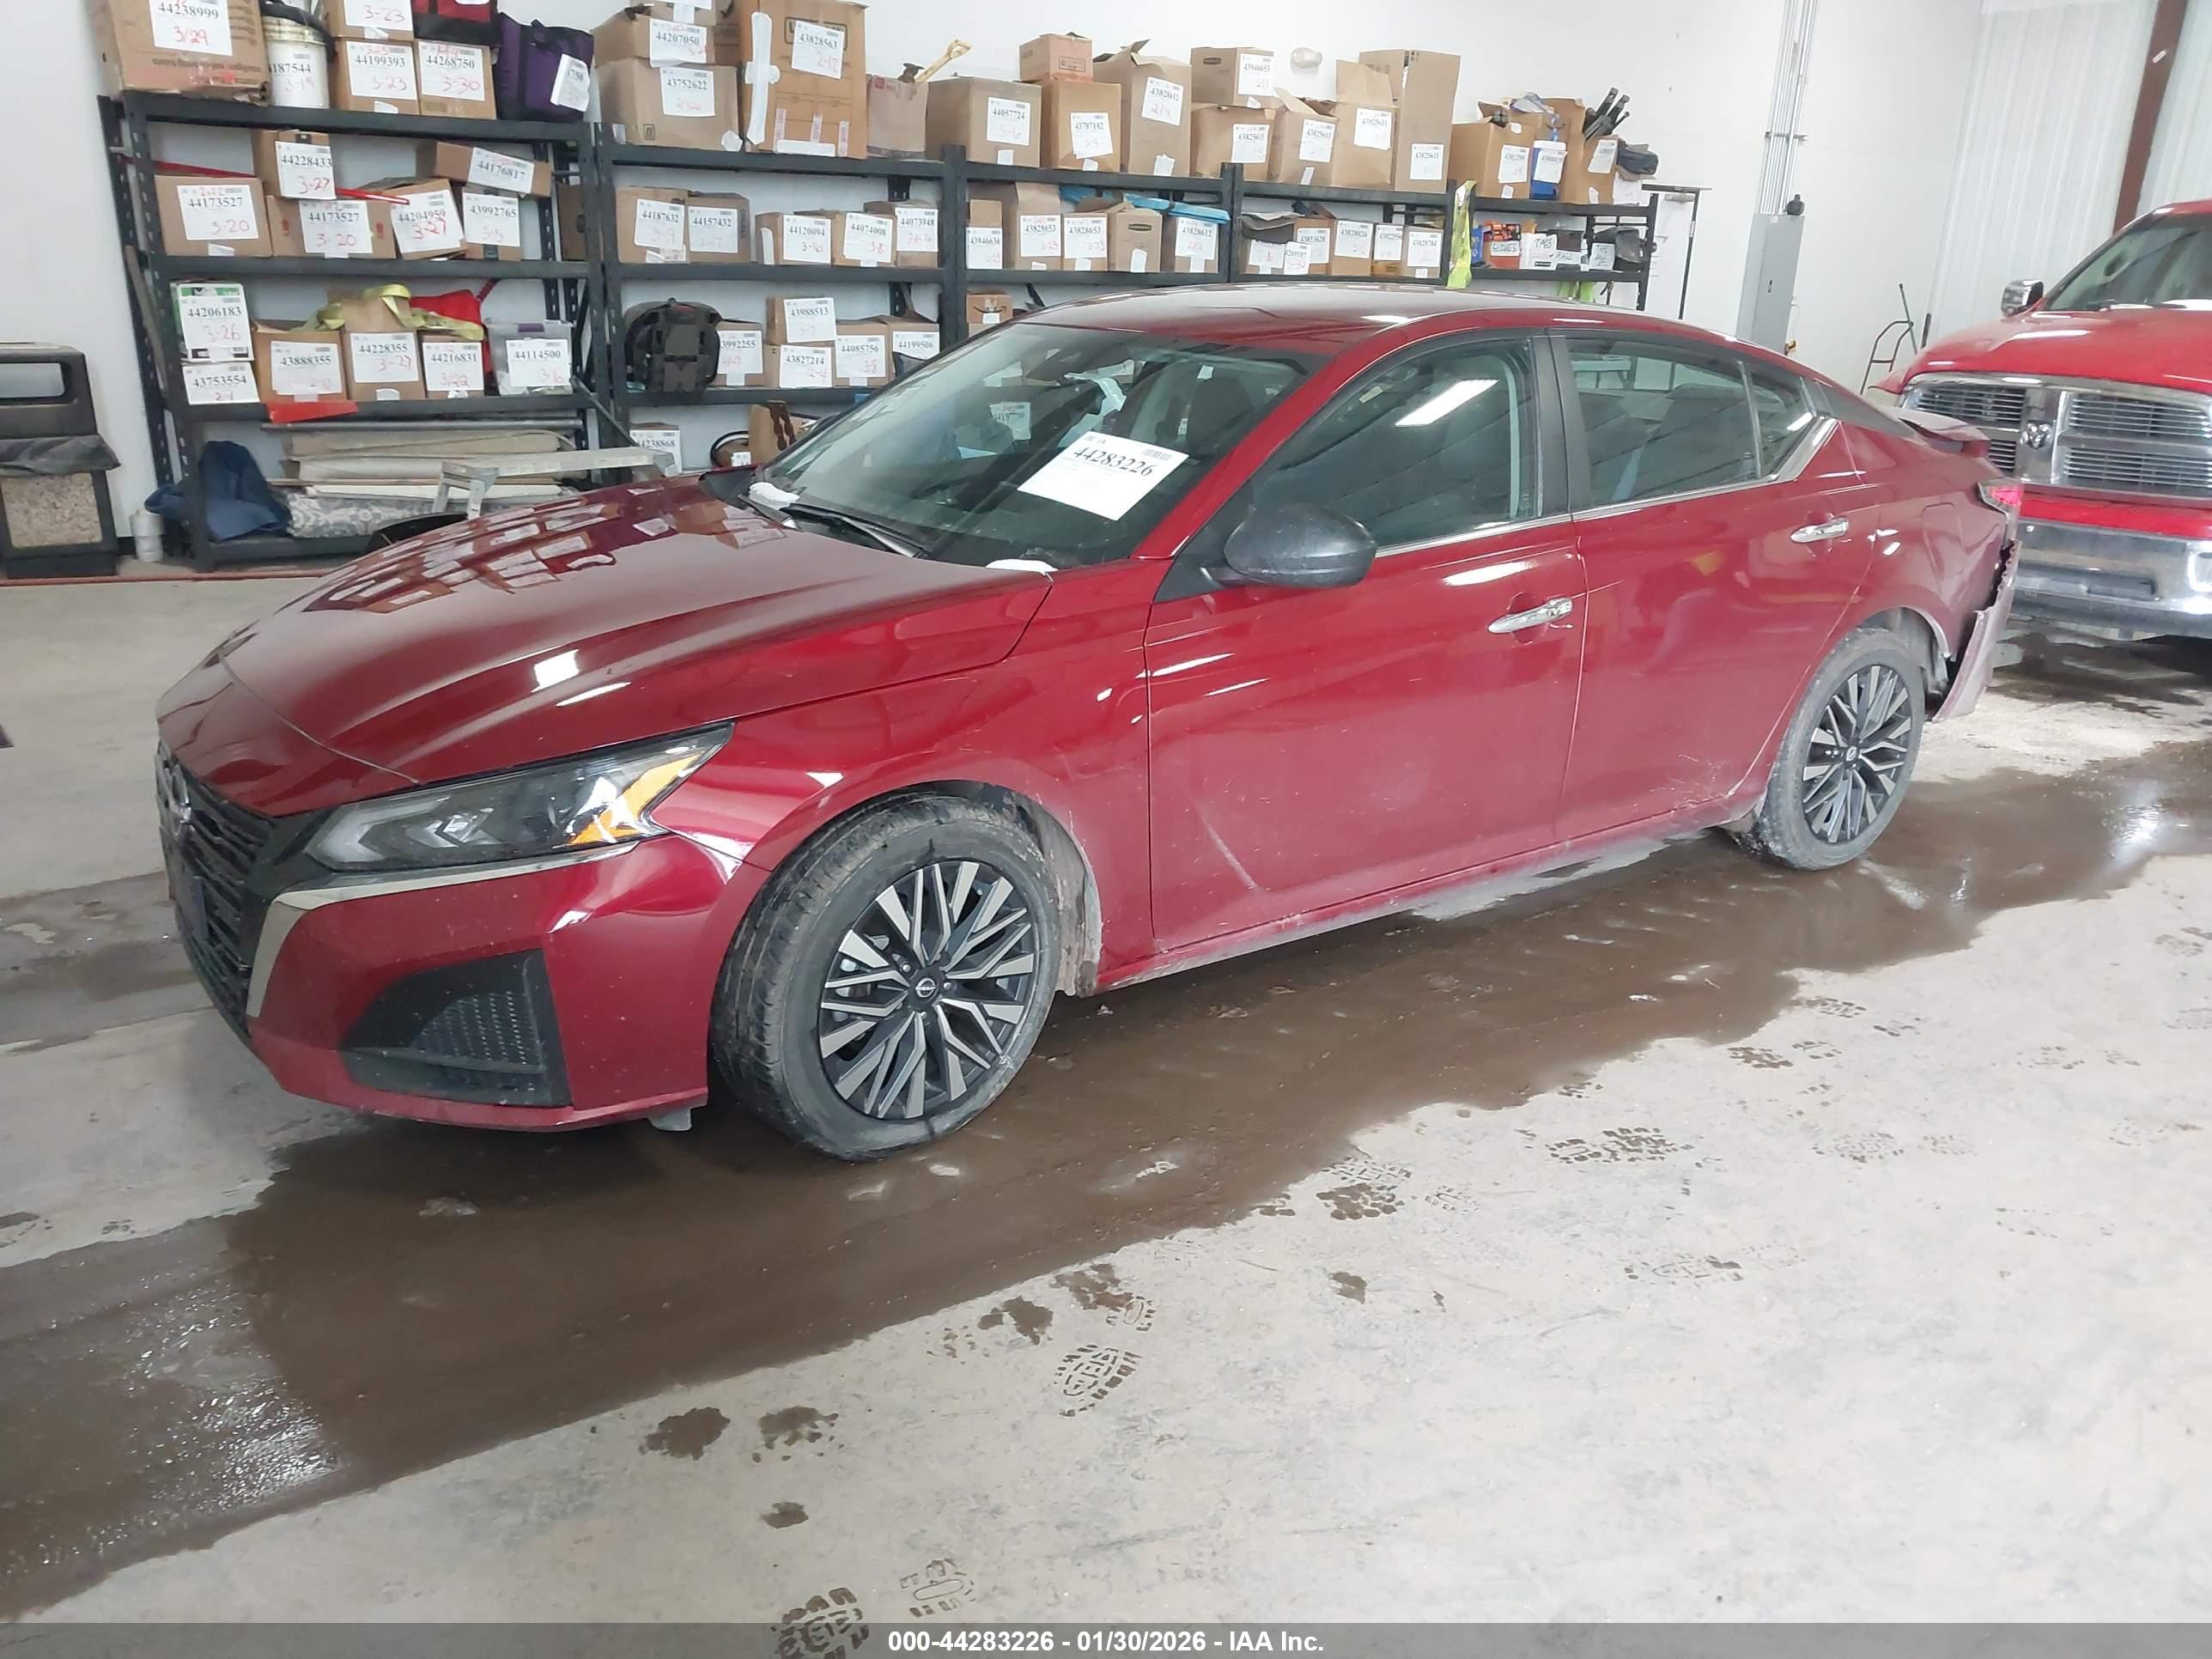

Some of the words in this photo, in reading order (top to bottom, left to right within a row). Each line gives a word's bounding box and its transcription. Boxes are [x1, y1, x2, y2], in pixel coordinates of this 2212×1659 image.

[158, 2, 219, 20] 44238999
[365, 5, 405, 22] 3-23
[173, 26, 210, 46] 3/29
[655, 31, 700, 46] 44207050
[799, 33, 838, 49] 43828563
[356, 55, 406, 68] 44199393
[426, 55, 475, 70] 44268750
[443, 76, 481, 94] 3-30
[666, 78, 708, 90] 43752622
[282, 155, 331, 167] 44228433
[477, 161, 526, 180] 44176817
[188, 197, 243, 208] 44173527
[308, 212, 360, 222] 44173527
[398, 209, 447, 222] 44204959
[470, 205, 517, 218] 43992765
[641, 210, 679, 223] 44187632
[693, 216, 732, 227] 44157432
[187, 307, 241, 318] 44206183
[204, 322, 241, 342] 3-26
[358, 343, 409, 354] 44228355
[721, 339, 757, 349] 3992255
[280, 355, 331, 367] 43888355
[430, 353, 477, 363] 44216831
[514, 349, 562, 360] 44114500
[785, 355, 824, 366] 43827214
[191, 374, 247, 388] 43753554
[1073, 447, 1158, 477] 44283226
